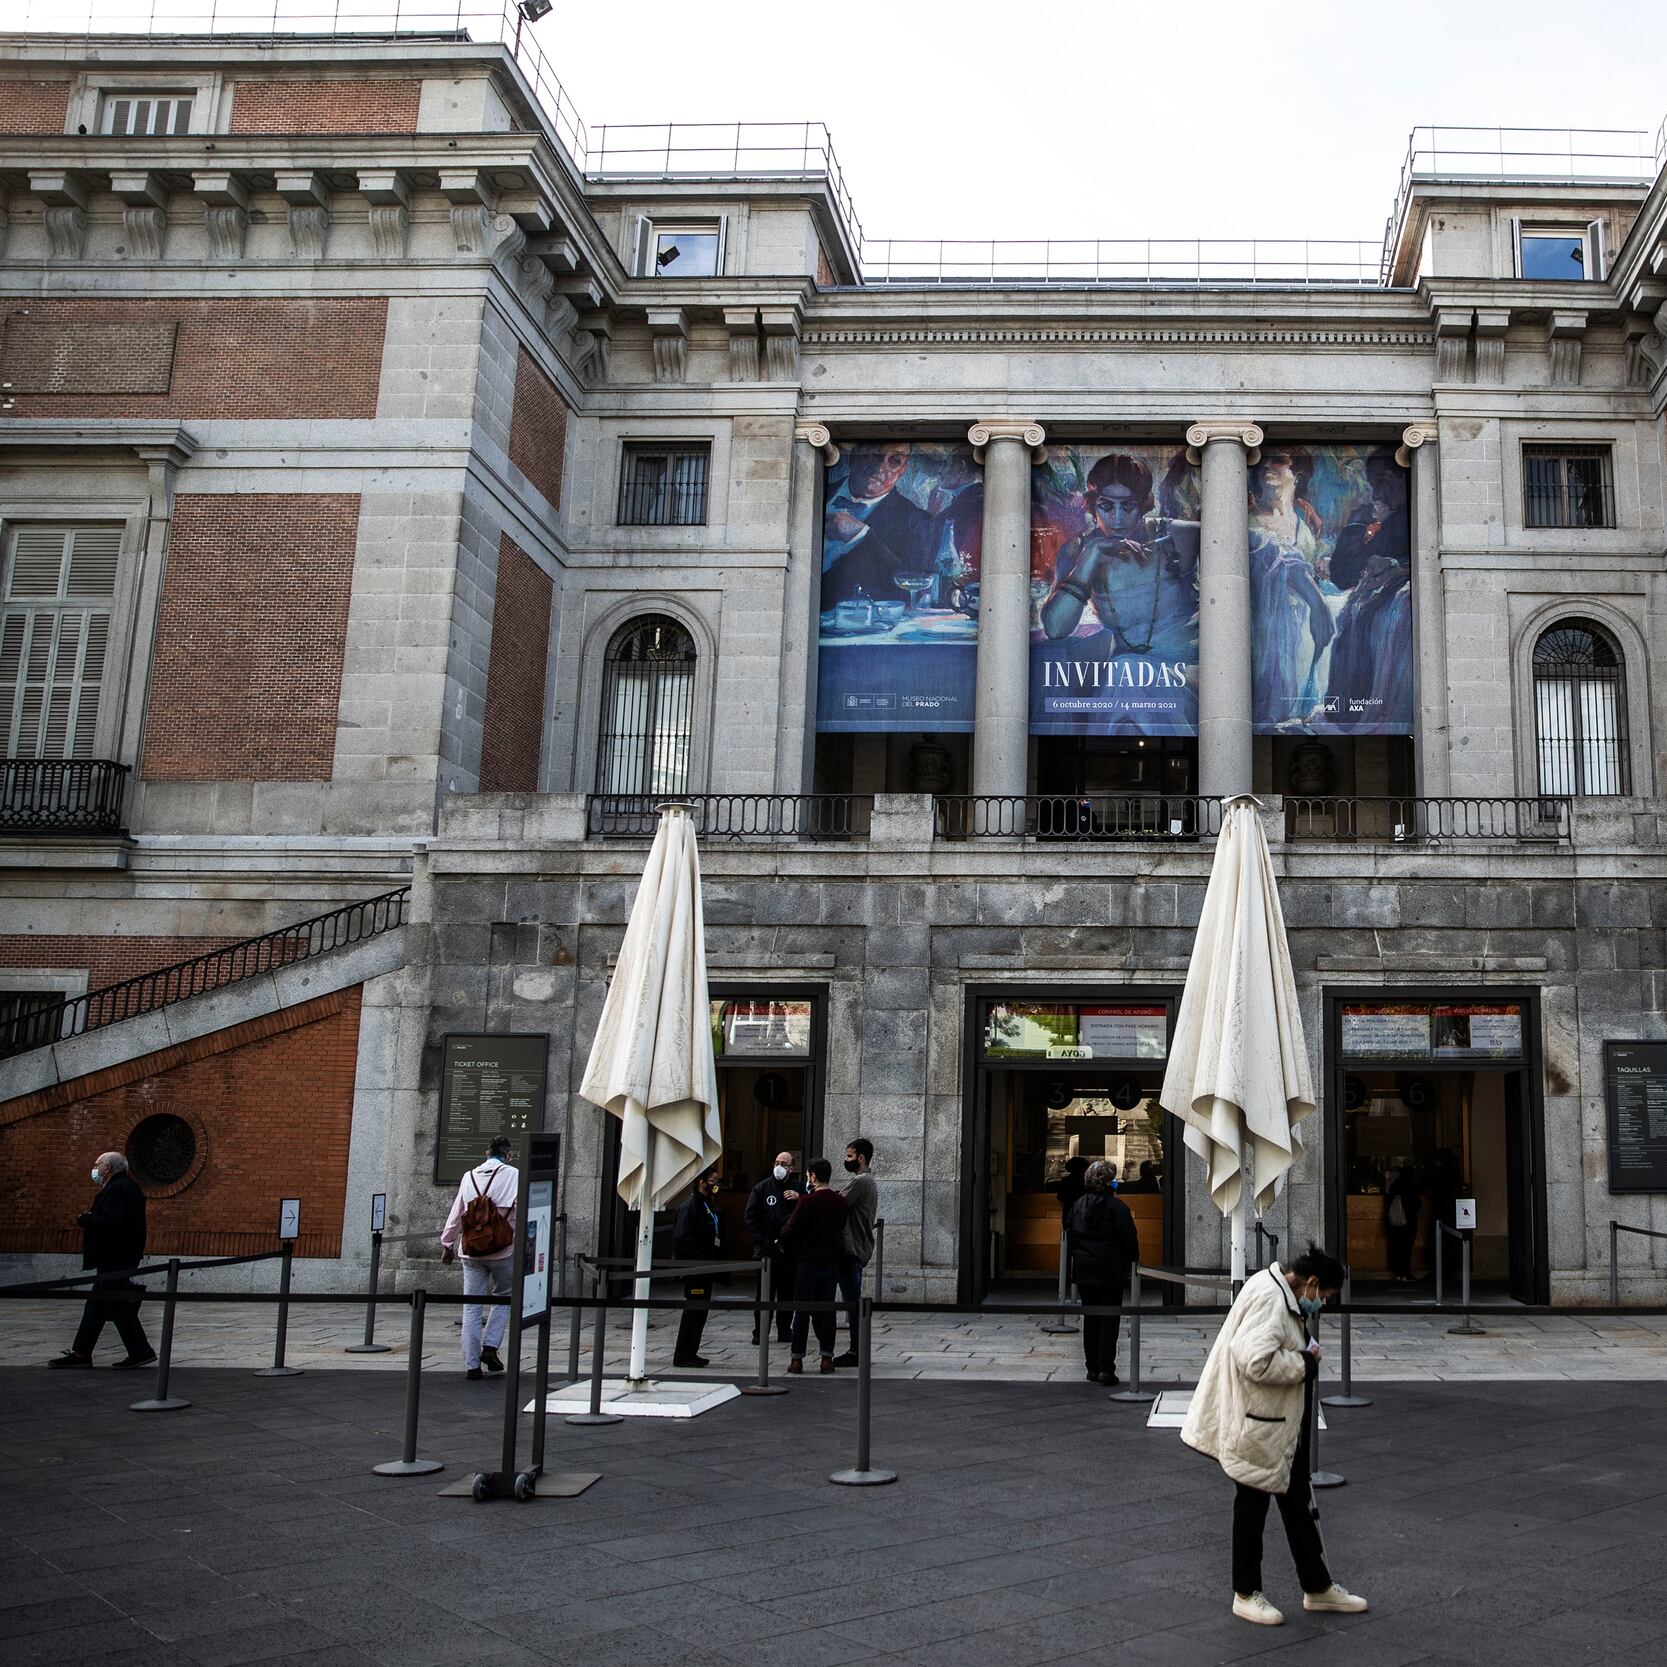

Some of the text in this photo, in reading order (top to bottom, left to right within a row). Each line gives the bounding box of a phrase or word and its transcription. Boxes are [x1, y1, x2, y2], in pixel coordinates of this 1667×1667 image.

[1042, 661, 1187, 687] INVITADAS
[1052, 699, 1058, 708] 6
[1059, 700, 1091, 708] octubre
[1120, 702, 1130, 711] 14
[1349, 697, 1383, 705] fundación
[1050, 1082, 1065, 1104] 3
[1115, 1082, 1133, 1104] 4
[1409, 1082, 1426, 1104] 6
